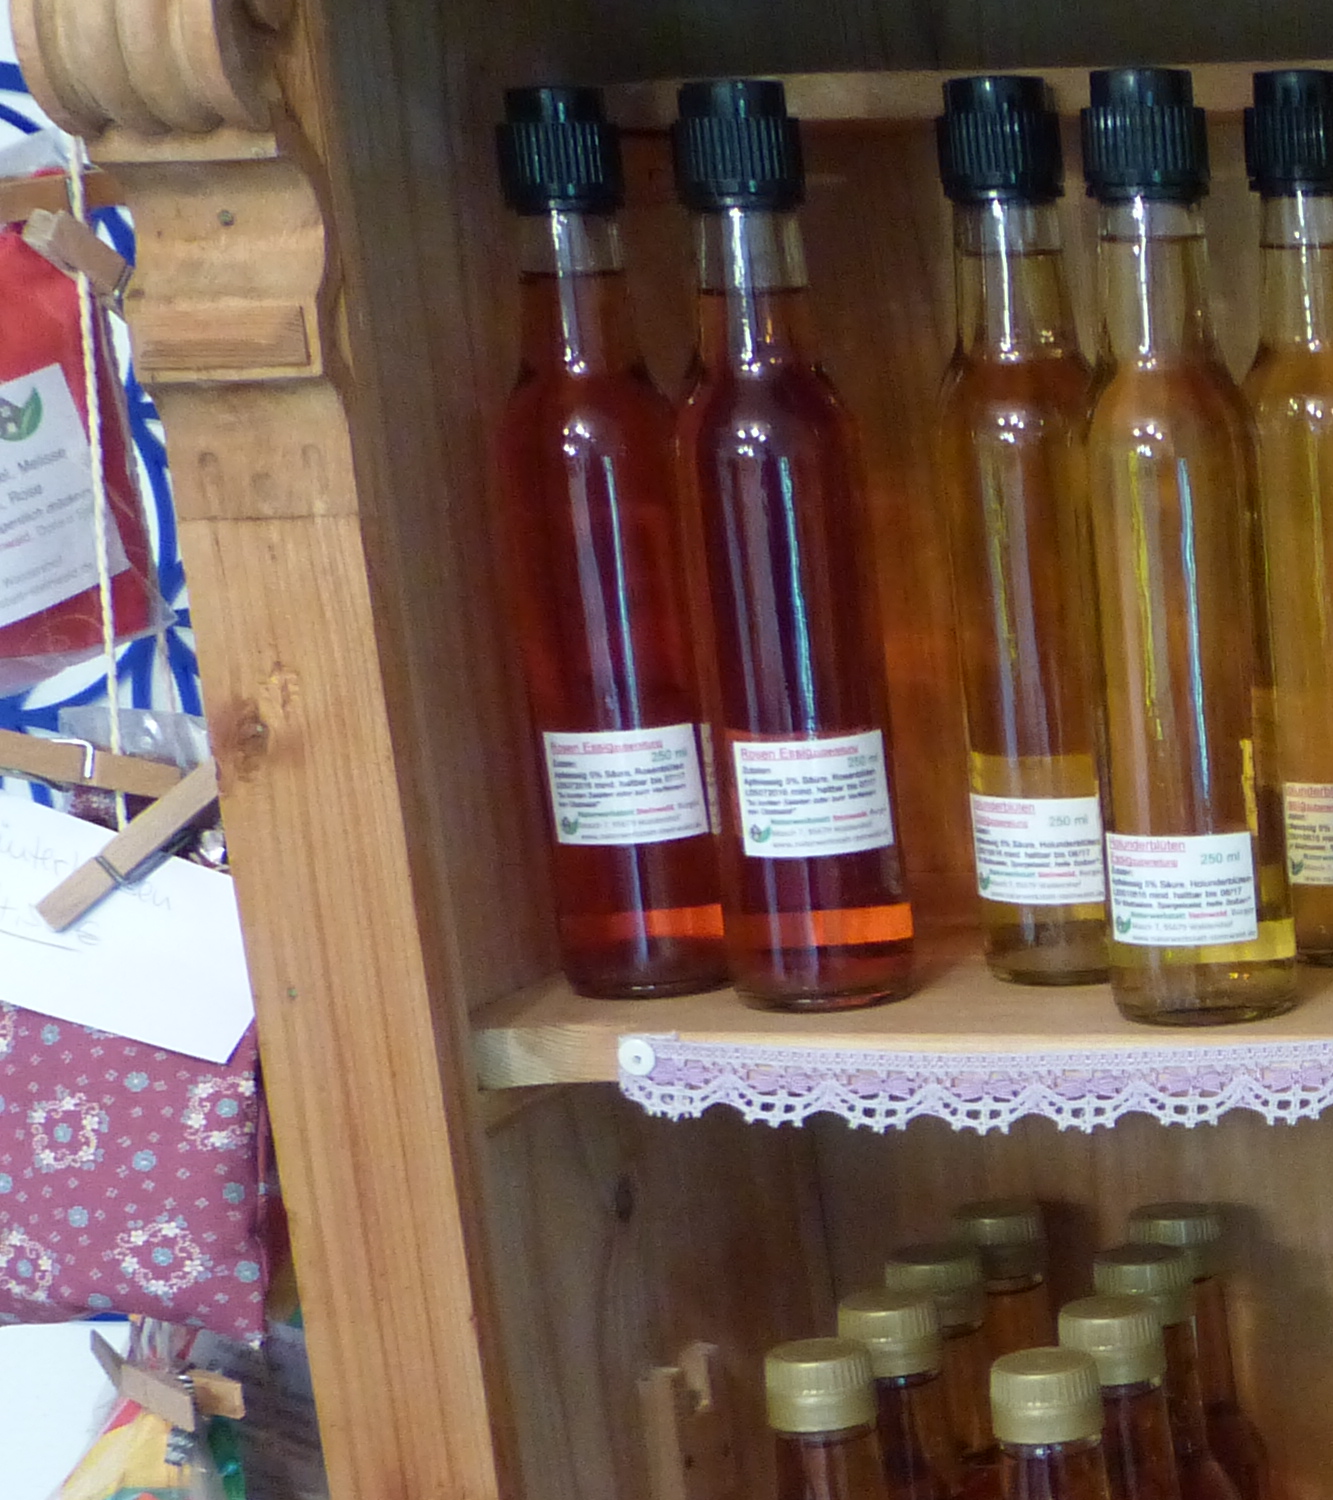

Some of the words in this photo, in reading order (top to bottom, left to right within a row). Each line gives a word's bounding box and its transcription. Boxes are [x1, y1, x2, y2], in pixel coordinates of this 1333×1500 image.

[1050, 816, 1070, 826] 250
[1201, 854, 1222, 864] 250
[1227, 852, 1240, 861] ml
